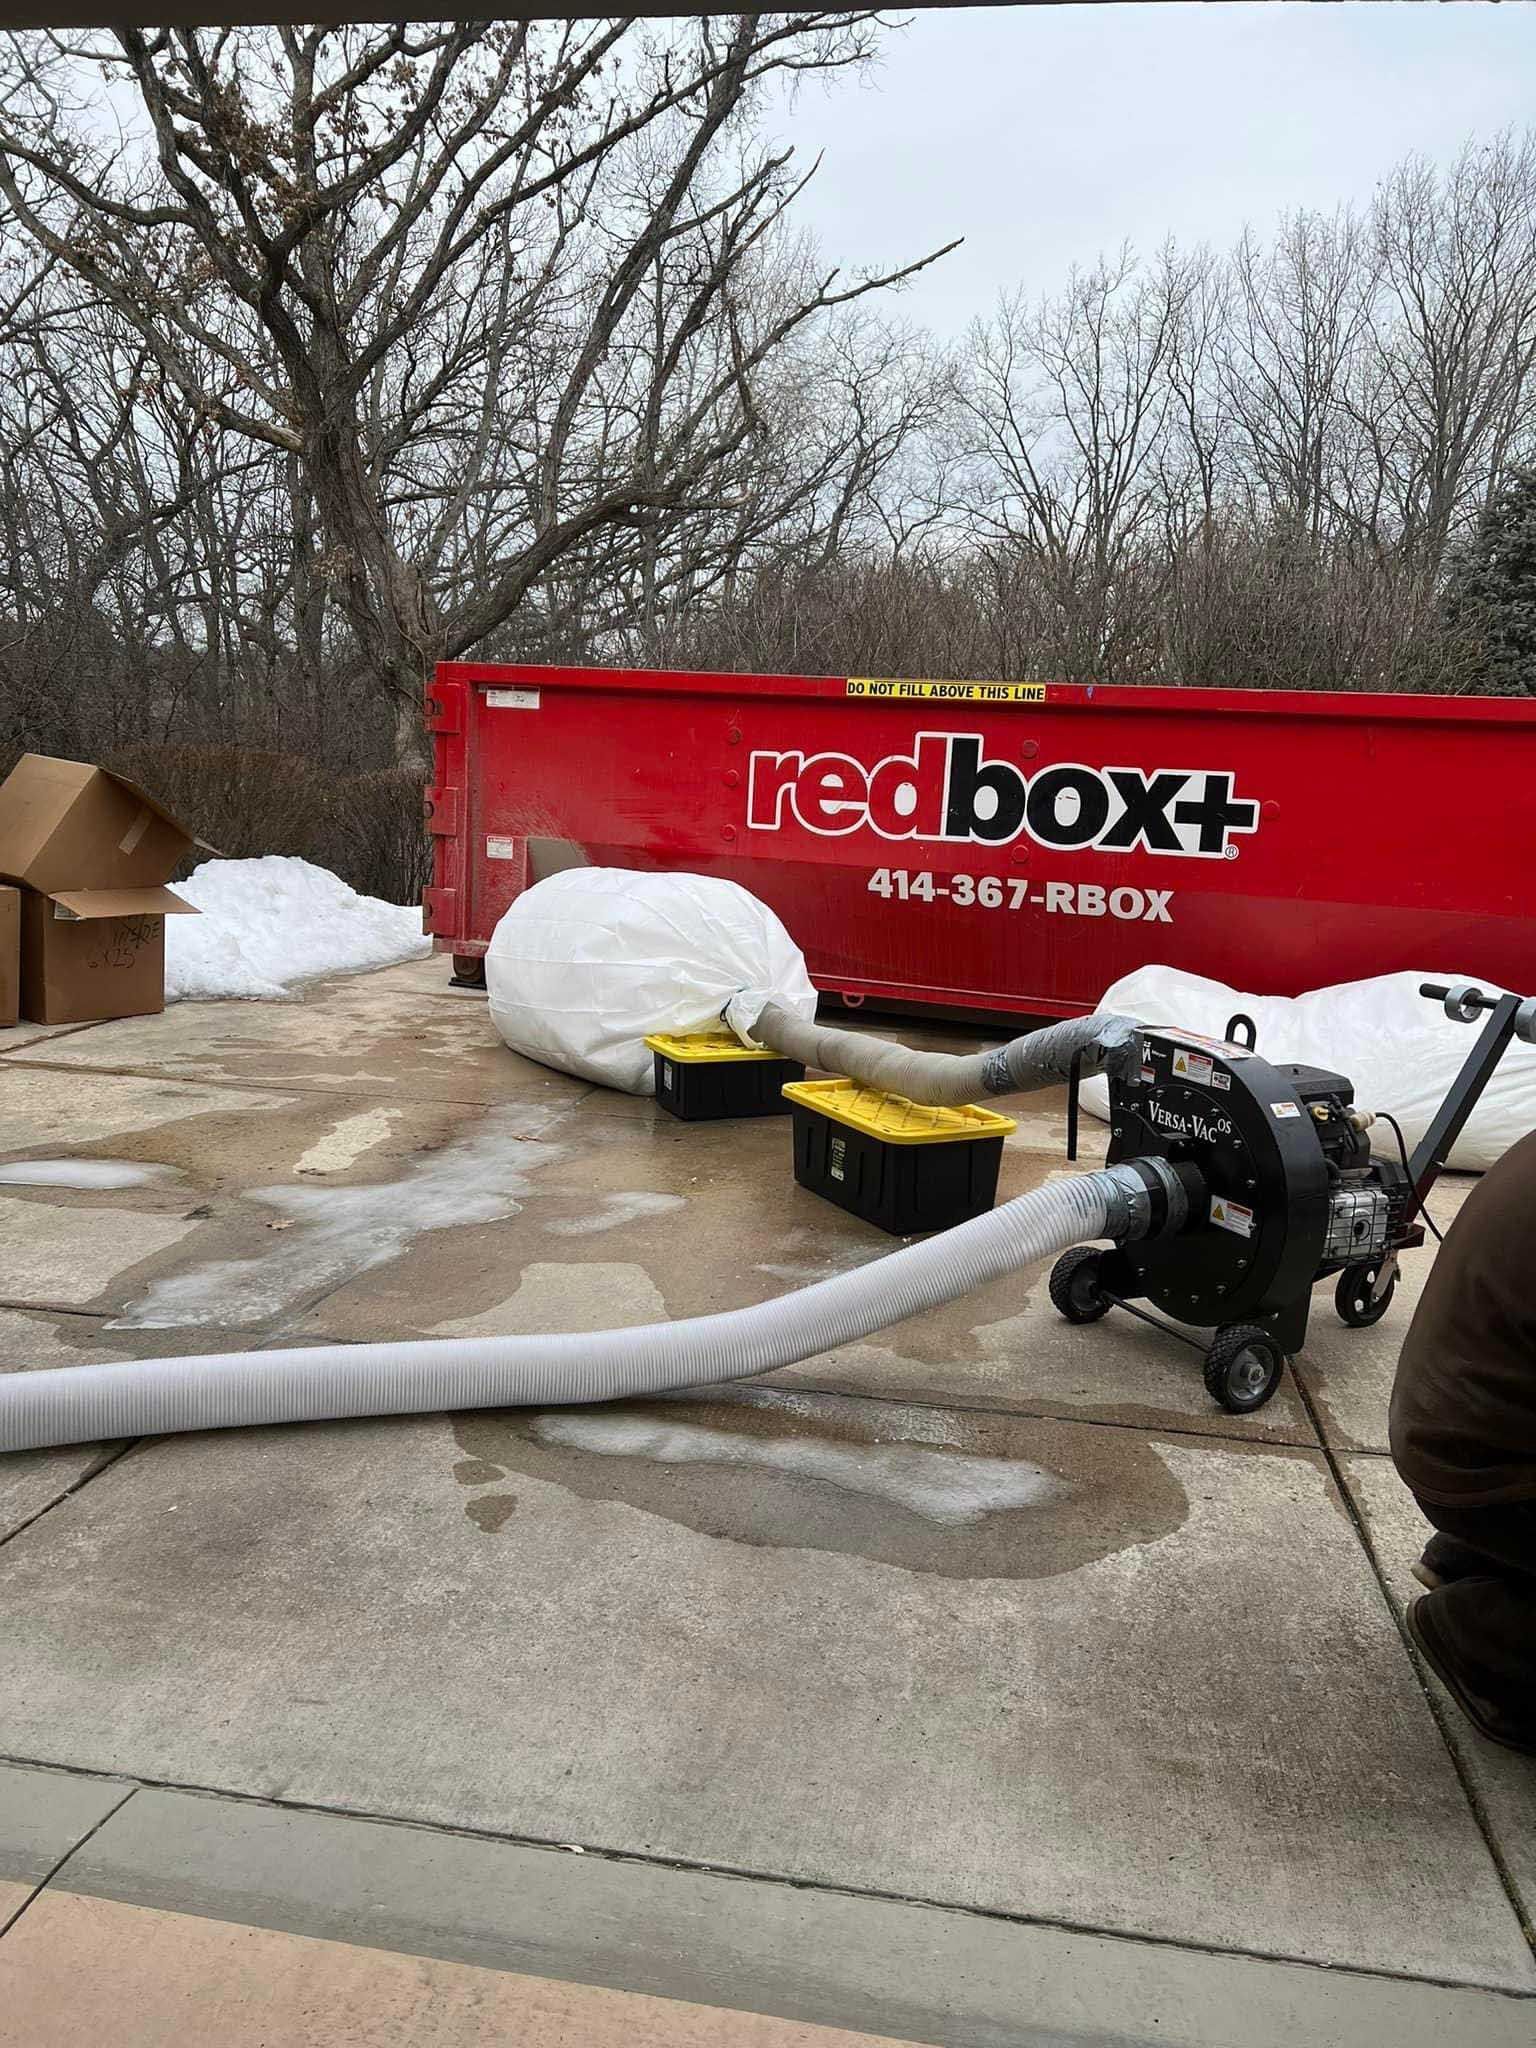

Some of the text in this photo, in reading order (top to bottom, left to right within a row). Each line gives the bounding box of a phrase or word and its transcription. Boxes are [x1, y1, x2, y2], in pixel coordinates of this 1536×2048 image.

[847, 682, 1045, 701] DO NOT FILL ABOVE THIS LINE
[867, 868, 1175, 923] 414-367-RBOX
